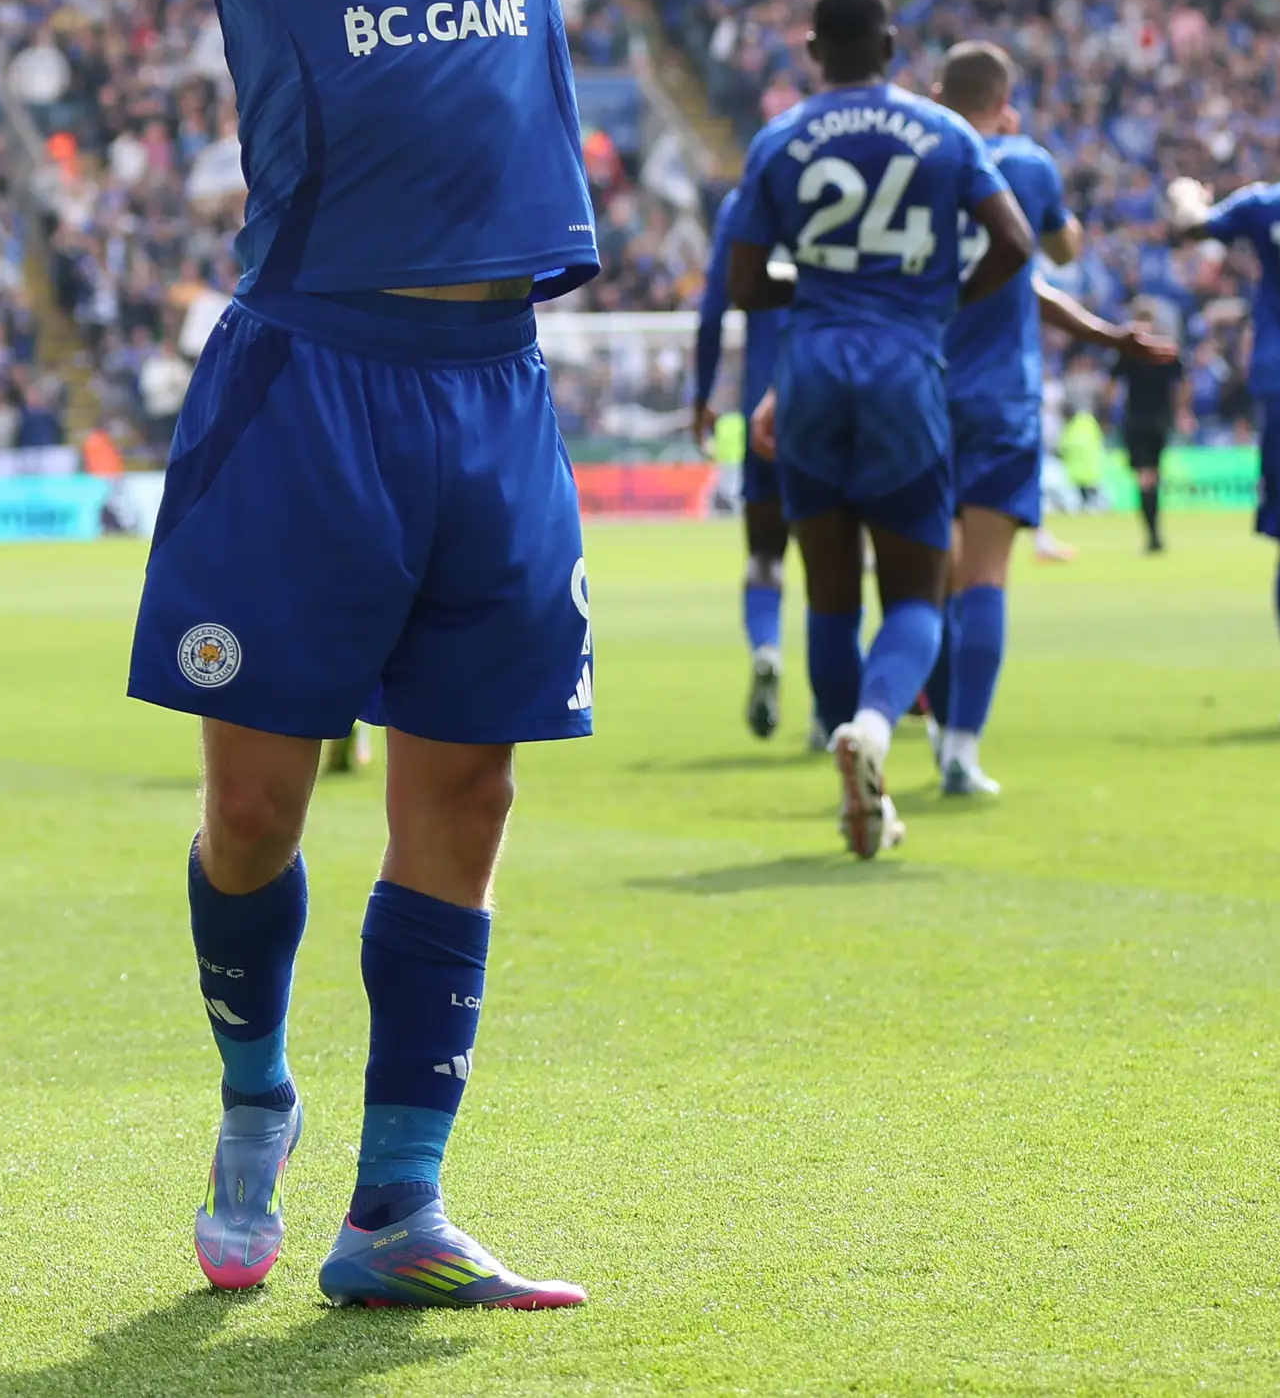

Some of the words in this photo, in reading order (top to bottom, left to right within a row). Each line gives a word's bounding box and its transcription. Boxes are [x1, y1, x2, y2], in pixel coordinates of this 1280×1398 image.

[795, 154, 937, 277] 24
[187, 629, 227, 648] LEICESTER
[226, 638, 237, 660] CITY
[184, 652, 213, 682] FOOTBALL
[213, 663, 233, 681] CLUB
